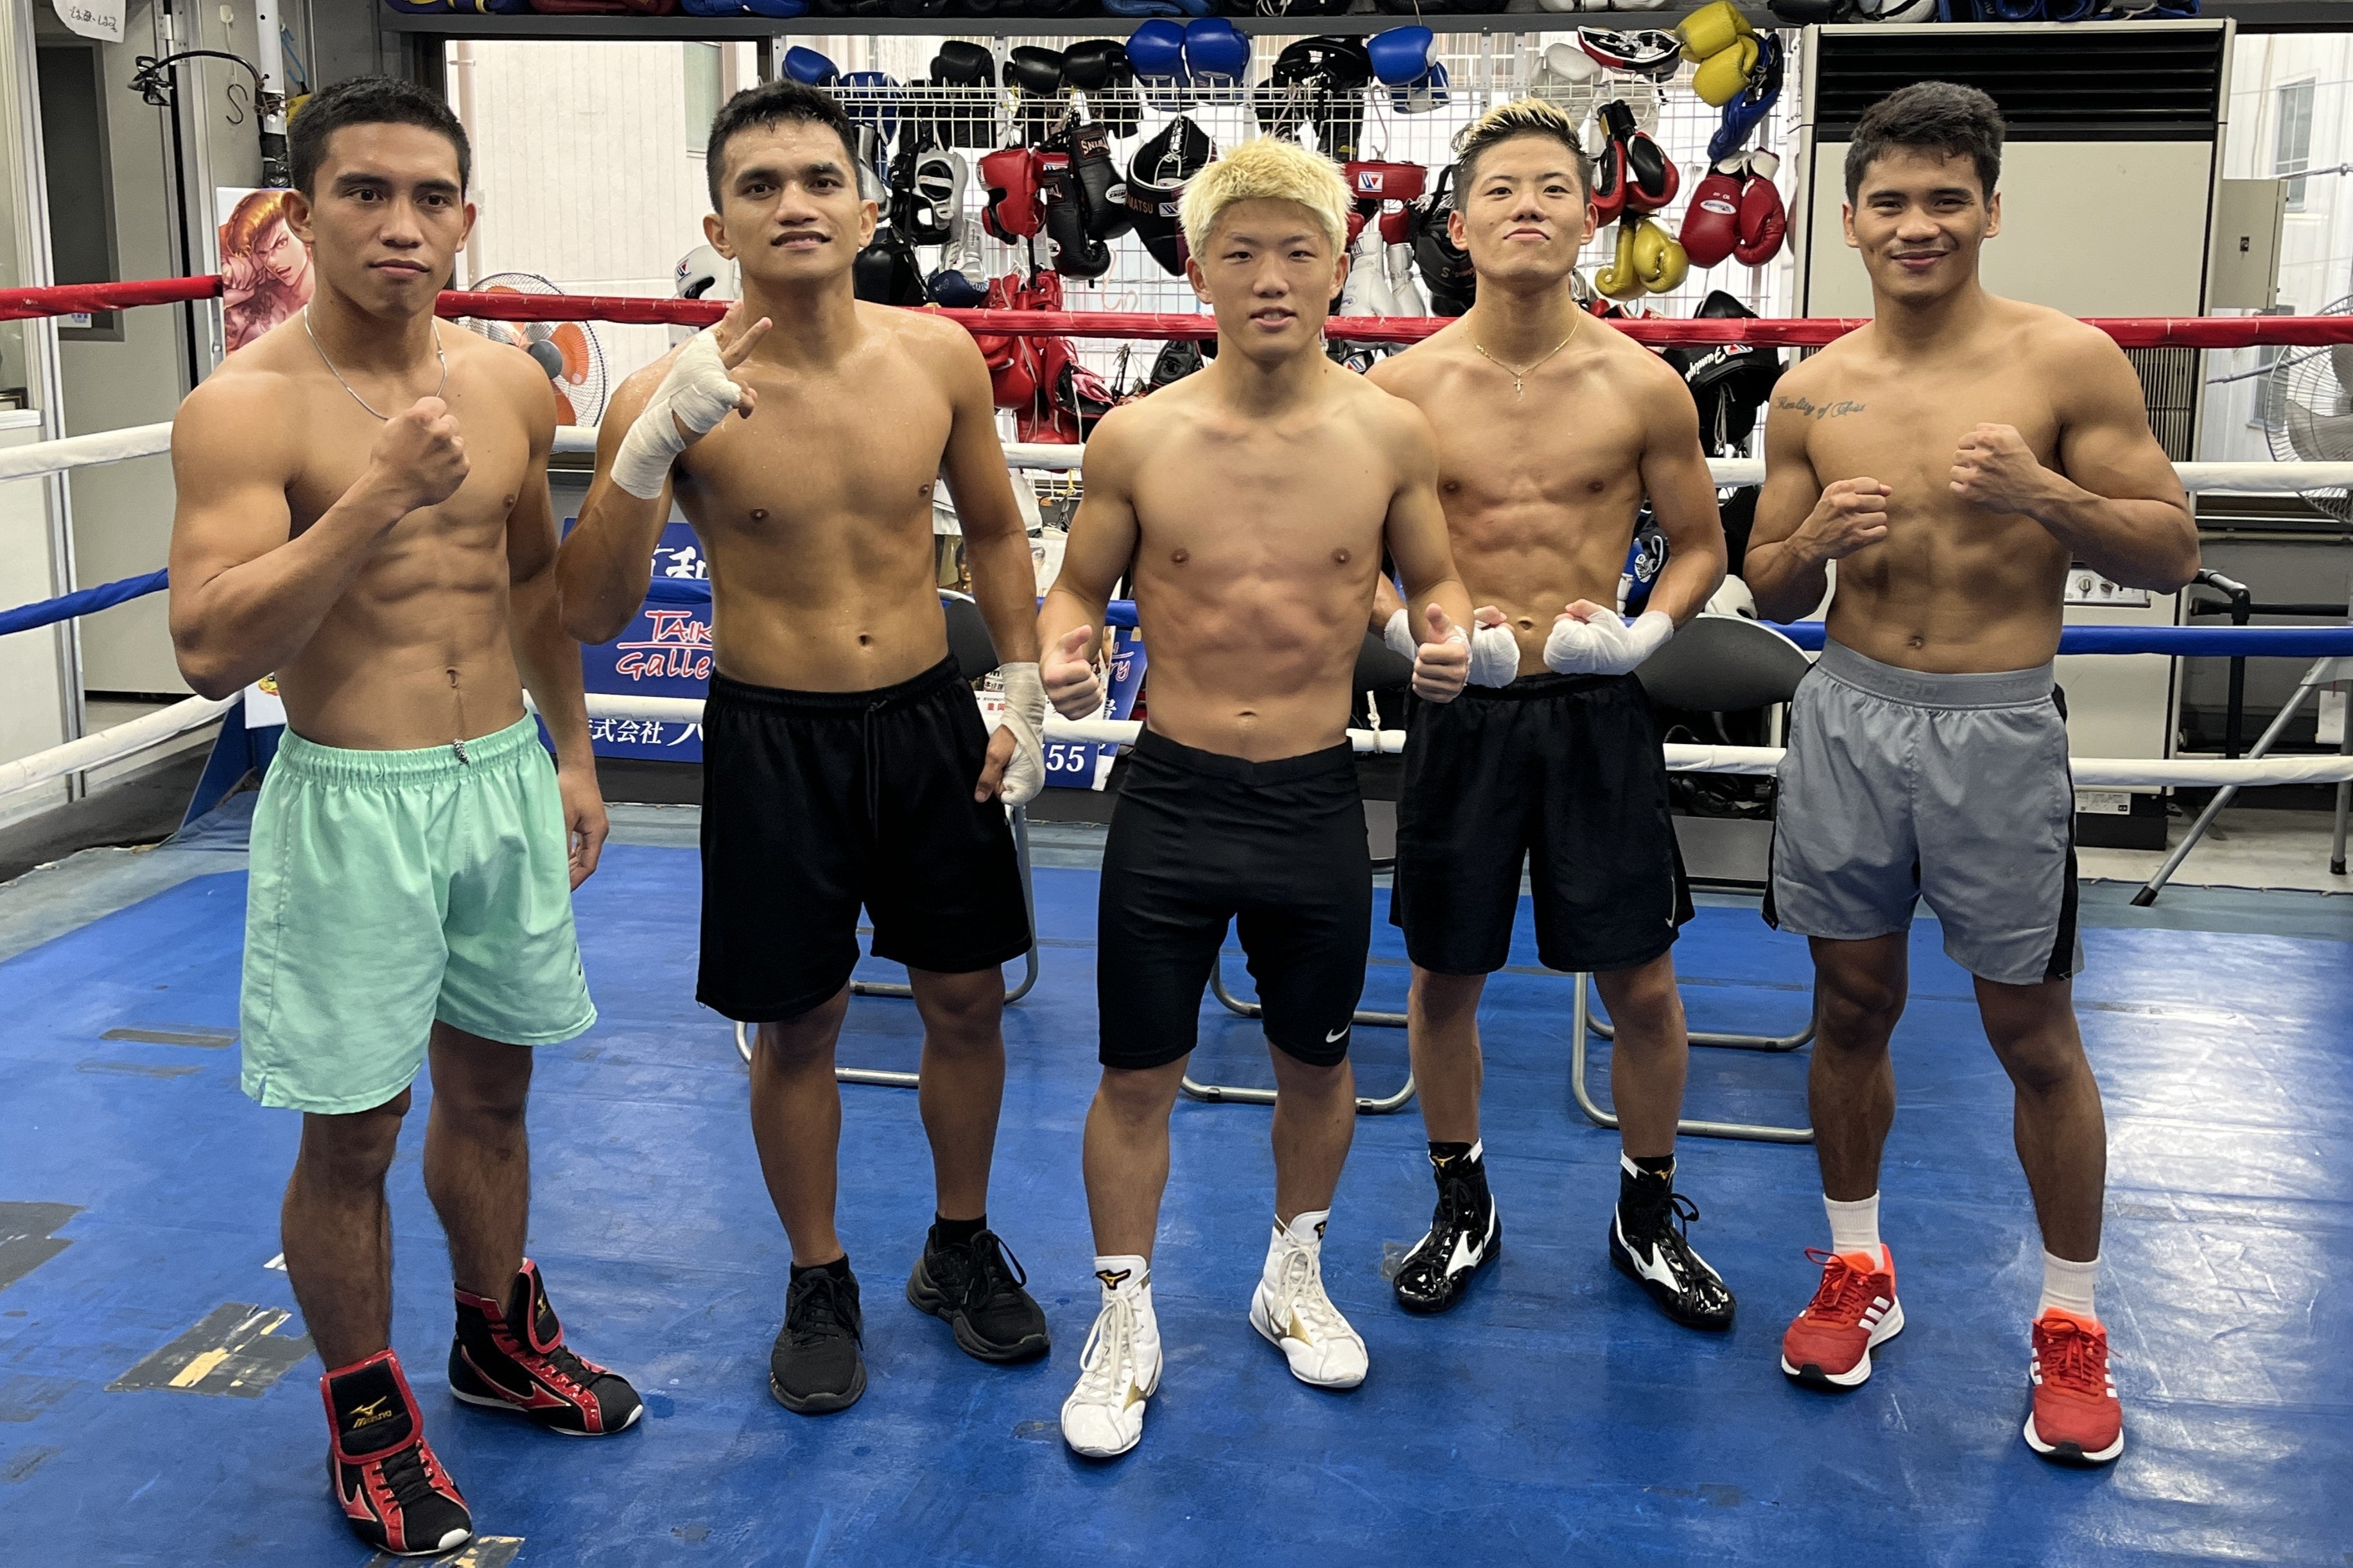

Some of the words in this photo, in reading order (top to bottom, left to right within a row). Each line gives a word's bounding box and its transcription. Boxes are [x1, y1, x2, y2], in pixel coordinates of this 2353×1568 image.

[589, 718, 664, 745] 式会社
[1041, 744, 1086, 772] 55
